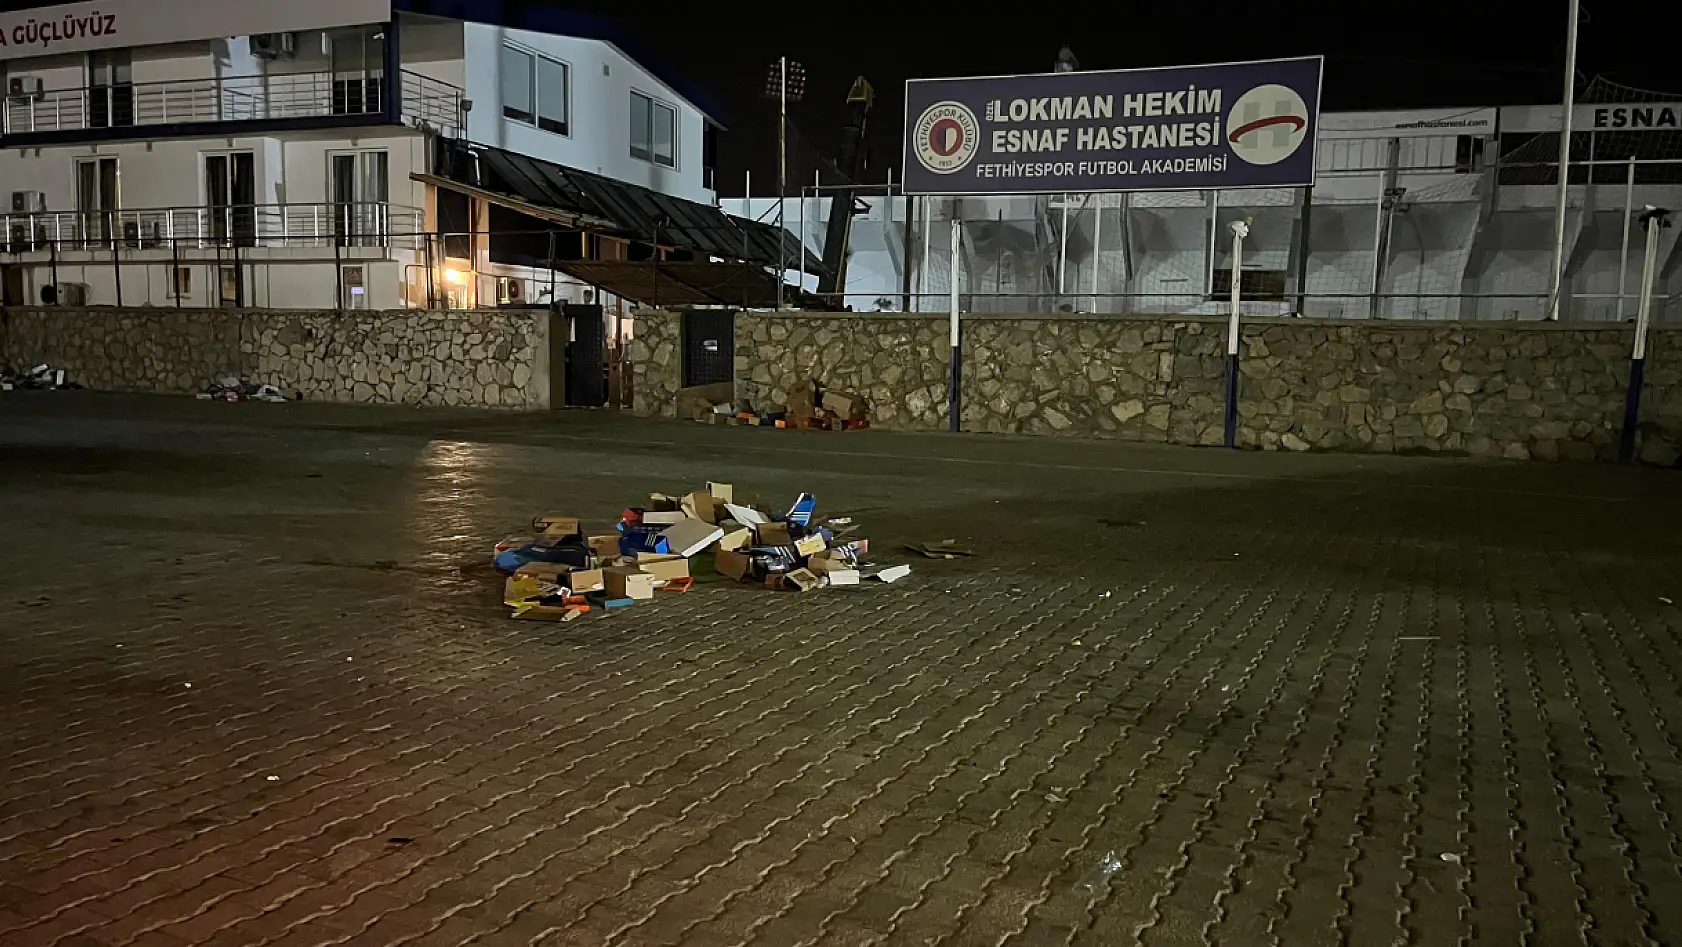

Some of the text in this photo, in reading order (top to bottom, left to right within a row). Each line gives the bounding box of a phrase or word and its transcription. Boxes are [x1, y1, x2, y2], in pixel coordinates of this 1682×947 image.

[12, 10, 117, 48] GÜÇLÜYÜZ
[993, 83, 1222, 123] LOKMAN HEKİM
[1594, 108, 1682, 128] ESNA
[992, 115, 1221, 153] ESNAF HASTANESİ
[976, 153, 1228, 178] FETHİYESPOR FUTBOL AKADEMİSİ
